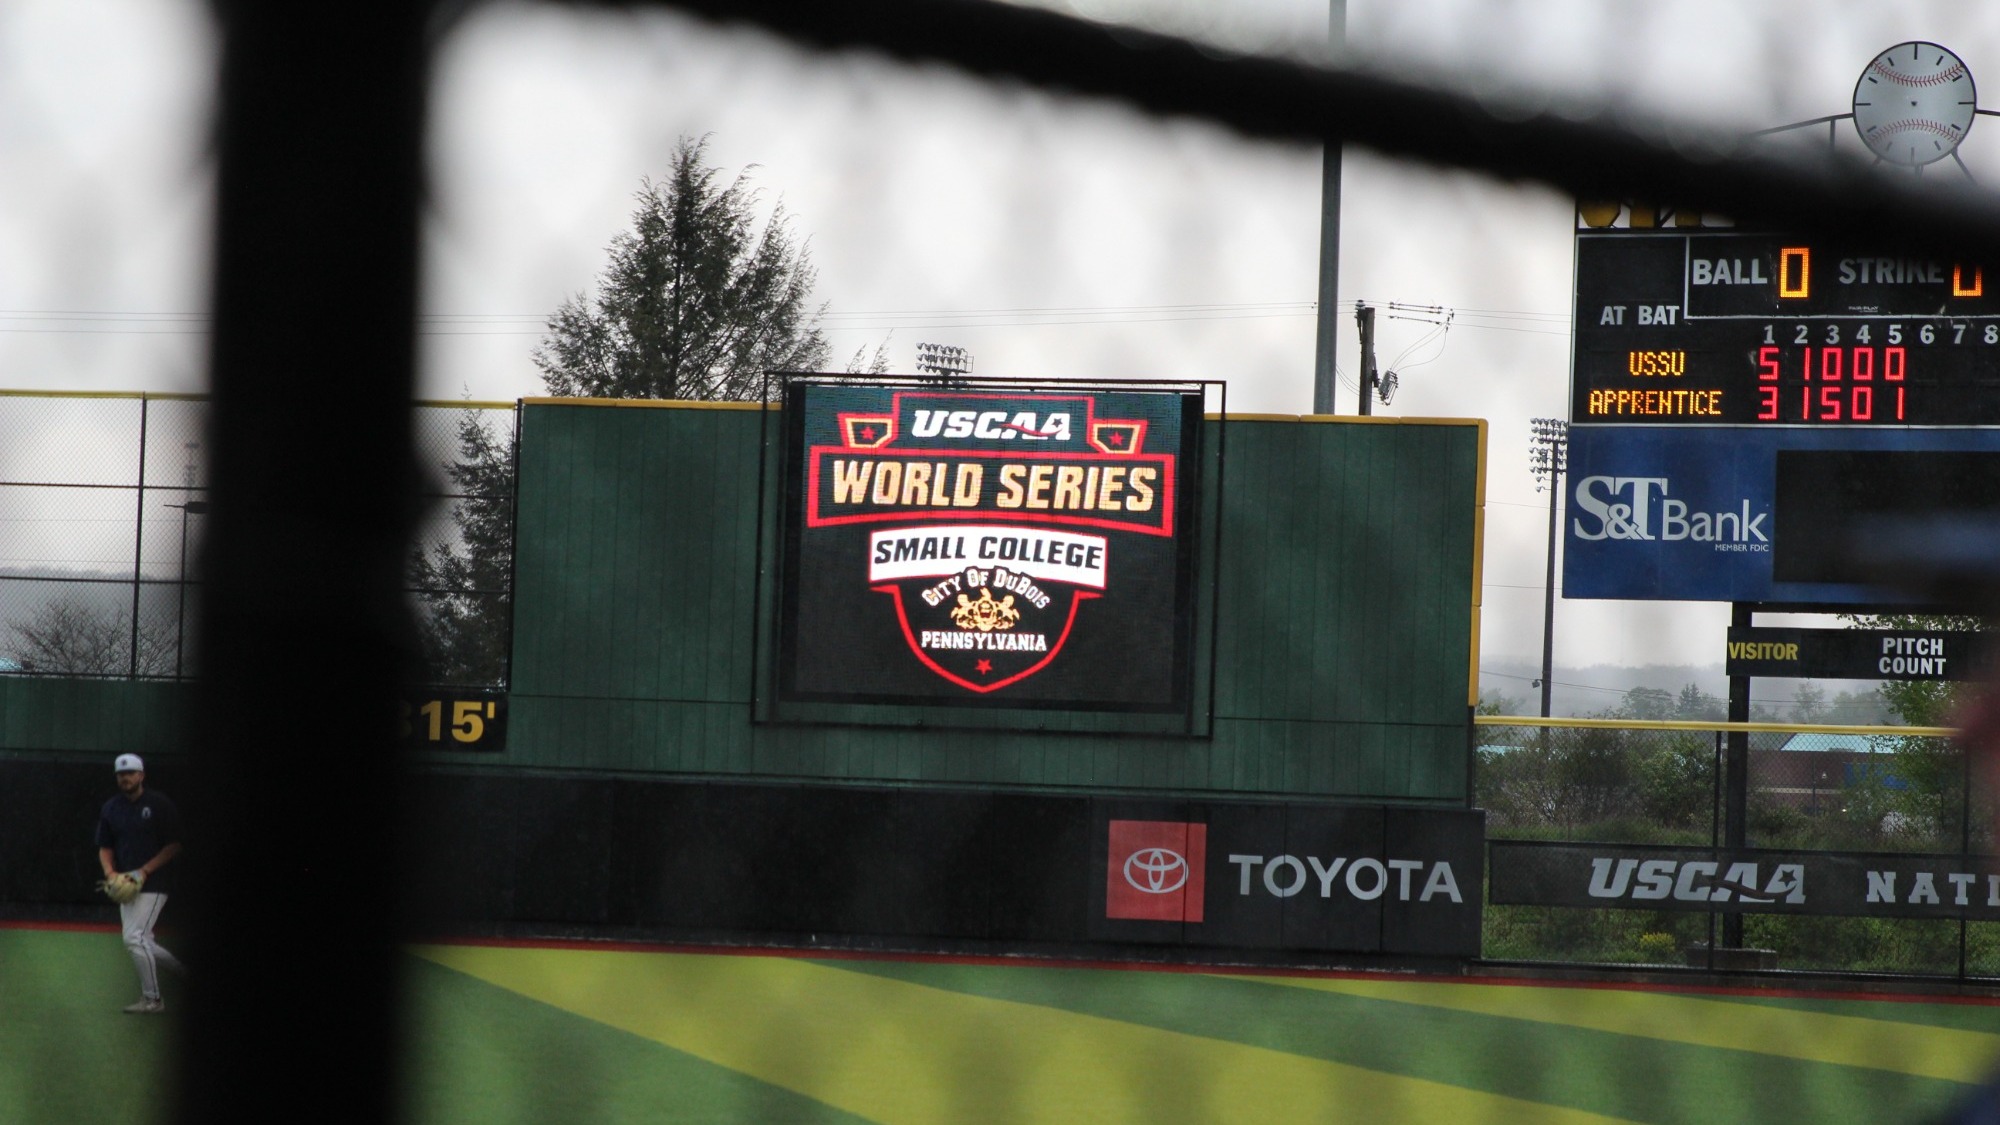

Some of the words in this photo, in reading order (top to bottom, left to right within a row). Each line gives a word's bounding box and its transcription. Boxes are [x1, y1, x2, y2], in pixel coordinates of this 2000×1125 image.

[1693, 258, 1768, 285] BALL
[1780, 248, 1809, 298] 0
[1838, 257, 1945, 285] STRIKE
[1600, 306, 1626, 325] AT
[1638, 305, 1680, 325] BAT
[1763, 324, 1776, 344] 1
[1794, 324, 1809, 344] 2
[1825, 324, 1841, 344] 3
[1856, 324, 1871, 344] 4
[1888, 324, 1903, 344] 5
[1919, 324, 1935, 344] 6
[1952, 324, 1967, 344] 7
[1983, 324, 1999, 344] 8
[1629, 351, 1685, 376] USSU
[1759, 347, 1780, 381] 5
[1804, 347, 1811, 381] 1
[1822, 347, 1842, 381] 0
[1853, 347, 1874, 381] 0
[1885, 347, 1905, 381] 0
[1589, 390, 1723, 415] APPRENTICE
[1758, 386, 1779, 420] 3
[1803, 386, 1810, 420] 1
[1820, 386, 1841, 420] 5
[1851, 386, 1872, 420] 0
[1897, 386, 1904, 420] 1
[911, 410, 1072, 441] USCAA
[832, 460, 984, 508] WORLD
[996, 464, 1157, 512] SERIES
[1574, 476, 1668, 541] S&T
[1662, 499, 1770, 543] Bank
[874, 536, 967, 565] SMALL
[977, 536, 1104, 570] COLLEGE
[1714, 544, 1748, 552] MEMBER
[1750, 544, 1770, 552] FDIC
[921, 630, 1048, 652] PENNSYLVANIA
[1728, 642, 1799, 661] VISITOR
[1882, 637, 1944, 657] PITCH
[1878, 656, 1947, 676] COUNT
[1229, 854, 1463, 903] TOYOTA
[1588, 858, 1806, 904] USCAA
